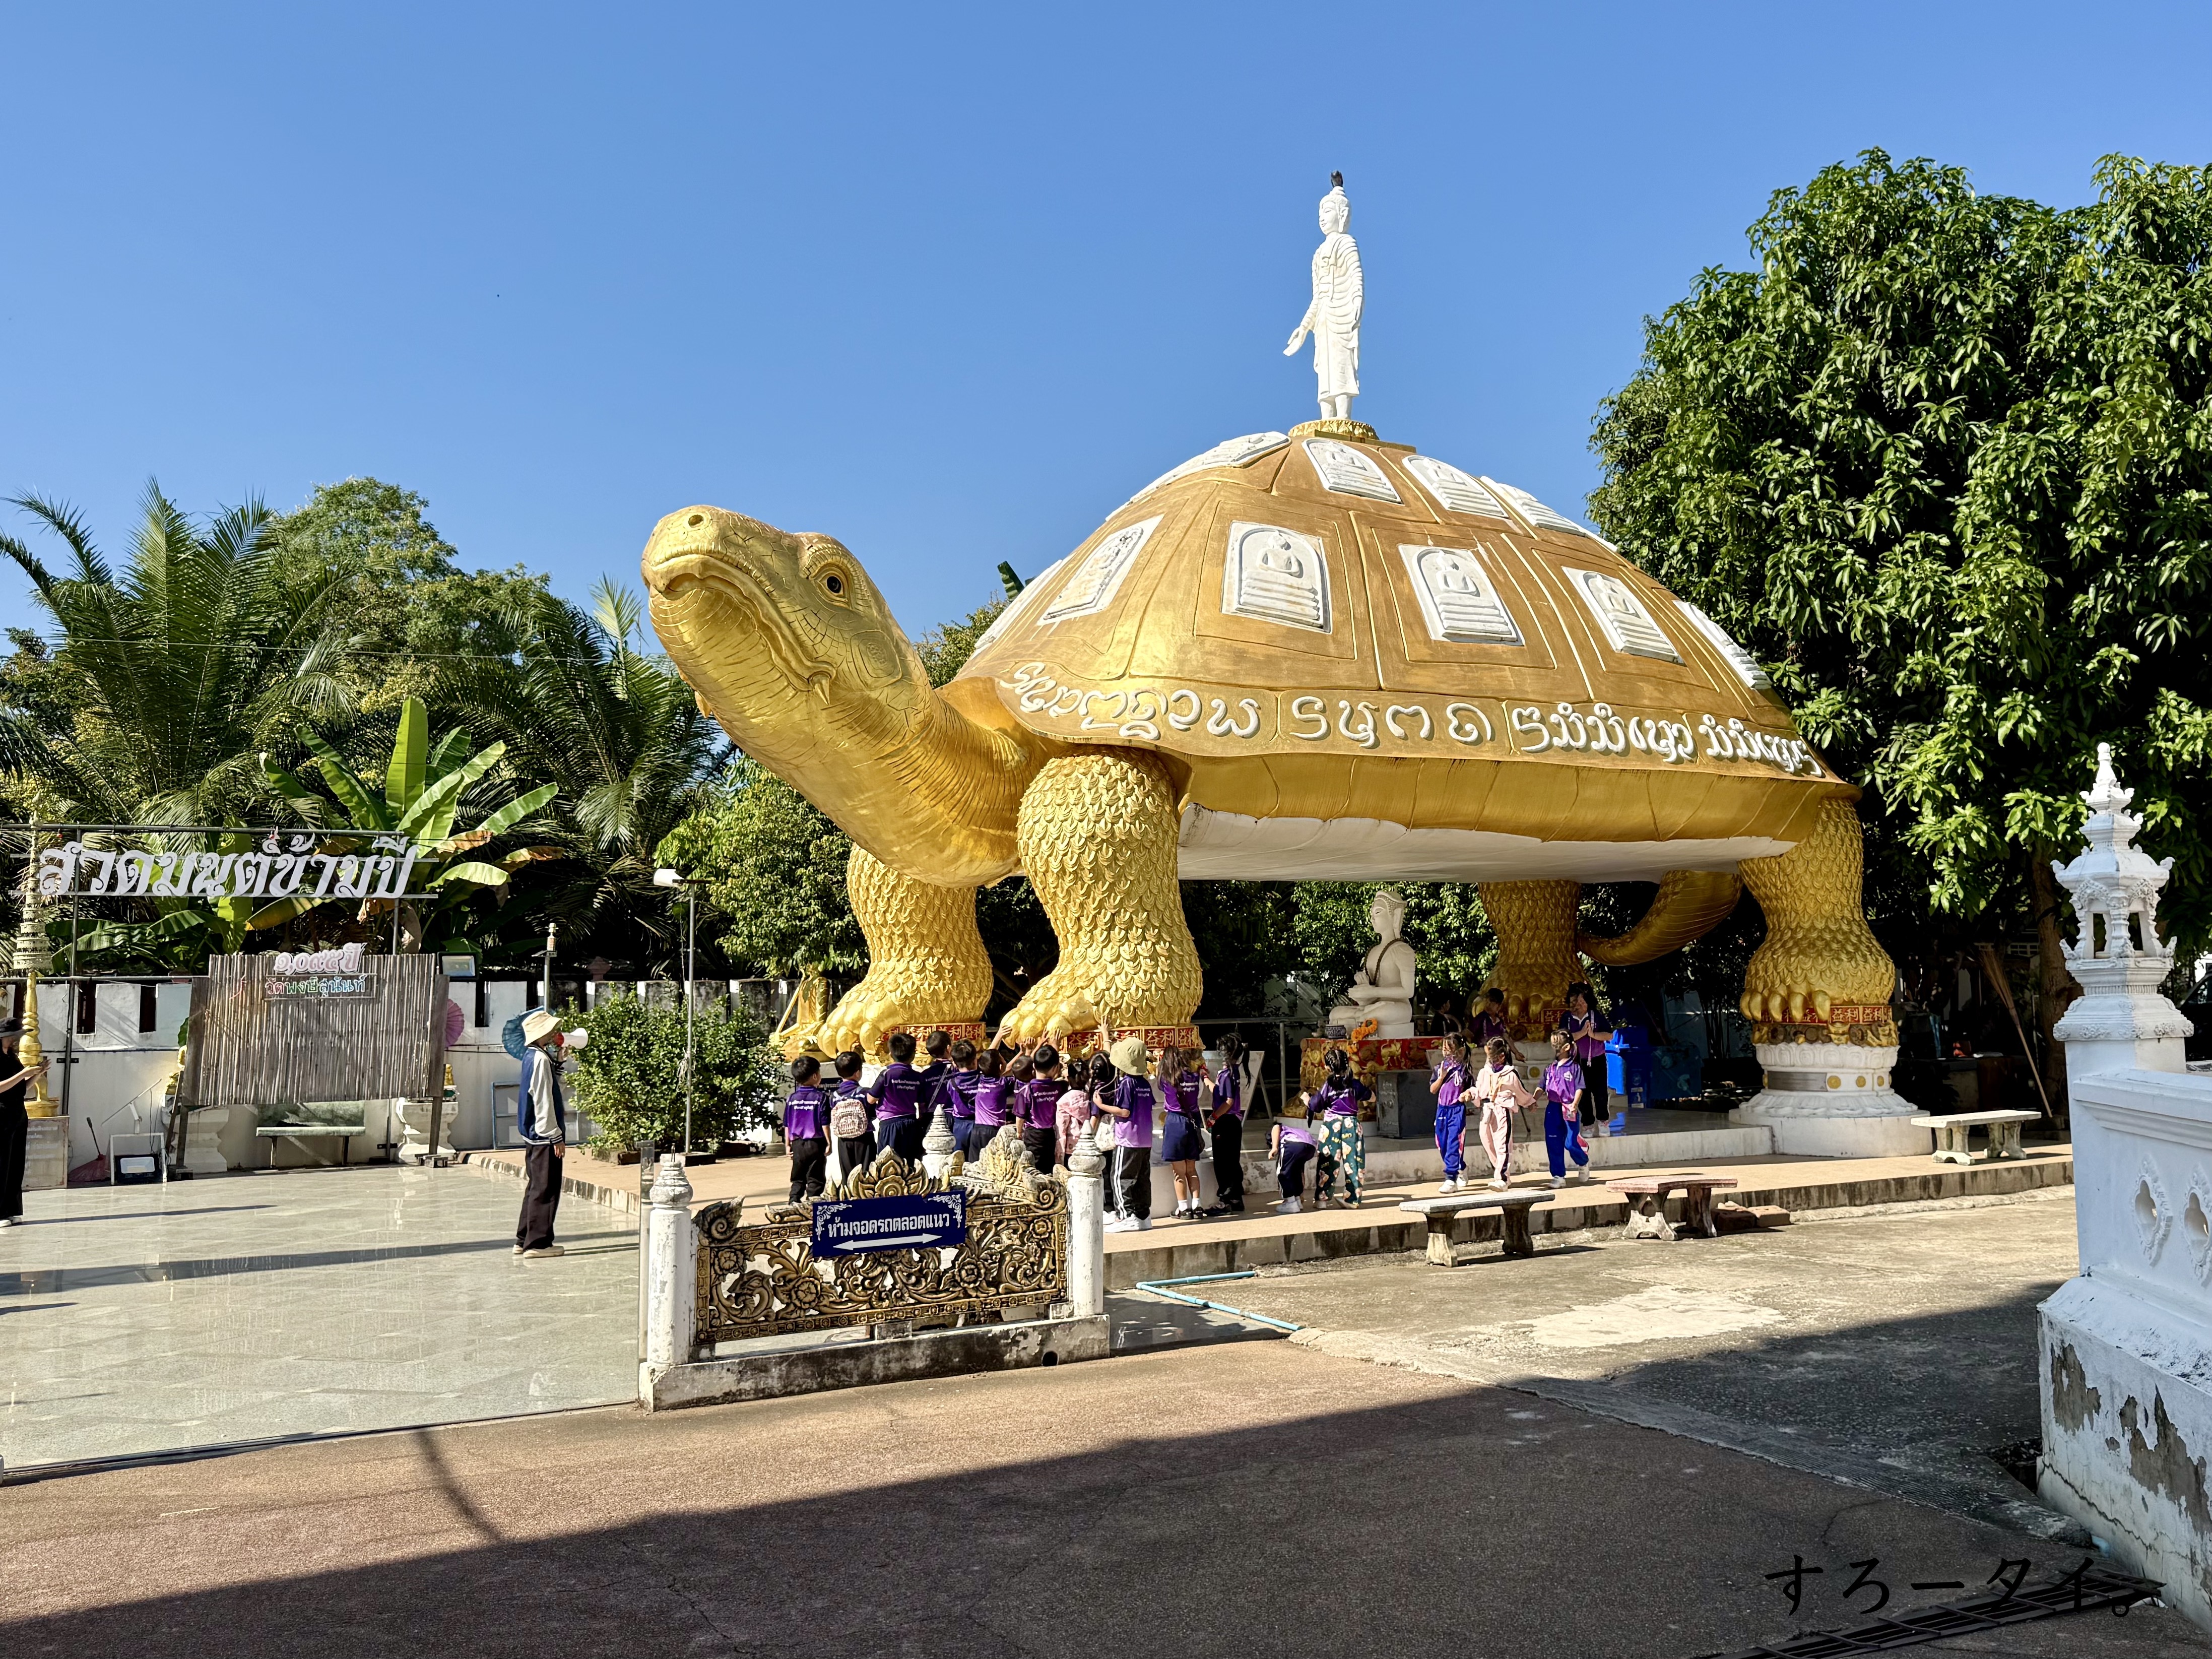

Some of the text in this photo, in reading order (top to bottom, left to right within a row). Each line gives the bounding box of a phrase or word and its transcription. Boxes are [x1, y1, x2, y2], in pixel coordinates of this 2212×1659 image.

[40, 833, 419, 899] สวดมนต์ข้ามปี
[1833, 1009, 1859, 1022] 益利
[1145, 1030, 1175, 1047] 益利
[828, 1213, 950, 1238] ห้ามจอดรถตลอดแนว
